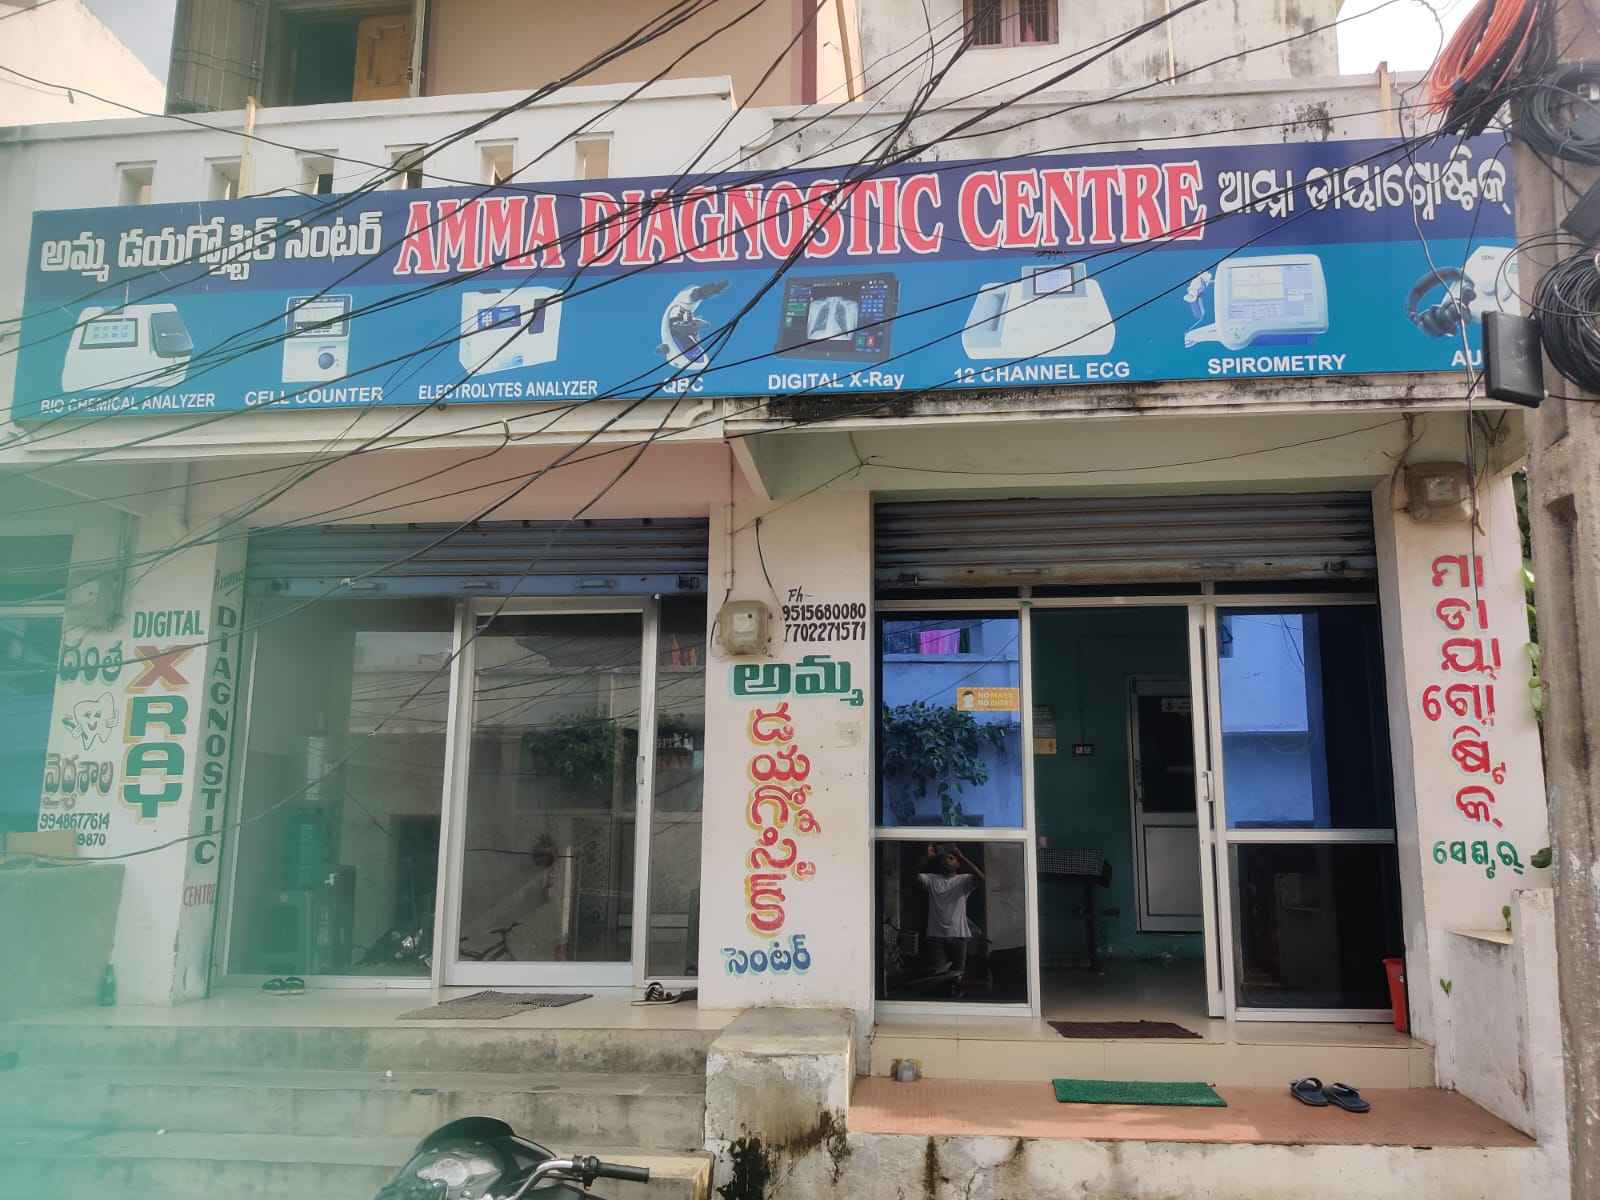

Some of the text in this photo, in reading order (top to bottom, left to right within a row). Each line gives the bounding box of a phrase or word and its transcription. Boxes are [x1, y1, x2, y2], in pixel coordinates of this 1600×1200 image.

[393, 160, 1207, 276] AMMA DIAGNOSTIC CENTRE
[40, 231, 109, 282] అమ్మ
[954, 361, 1131, 384] 12 CHANNEL ECG
[1208, 354, 1346, 374] SPIROMETRY
[419, 379, 598, 399] ELECTROLYTES ANALYZER
[768, 371, 905, 391] DIGITAL X-Ray
[40, 400, 64, 414] BIO
[142, 392, 216, 409] ANALYZER
[245, 386, 383, 406] CELL COUNTER
[783, 602, 867, 622] 9515680080
[132, 610, 205, 639] DIGITAL
[784, 621, 866, 643] 7702271571
[732, 654, 865, 707] అమ్మ
[40, 811, 110, 830] 9948677614
[723, 934, 812, 976] సెంటర్
